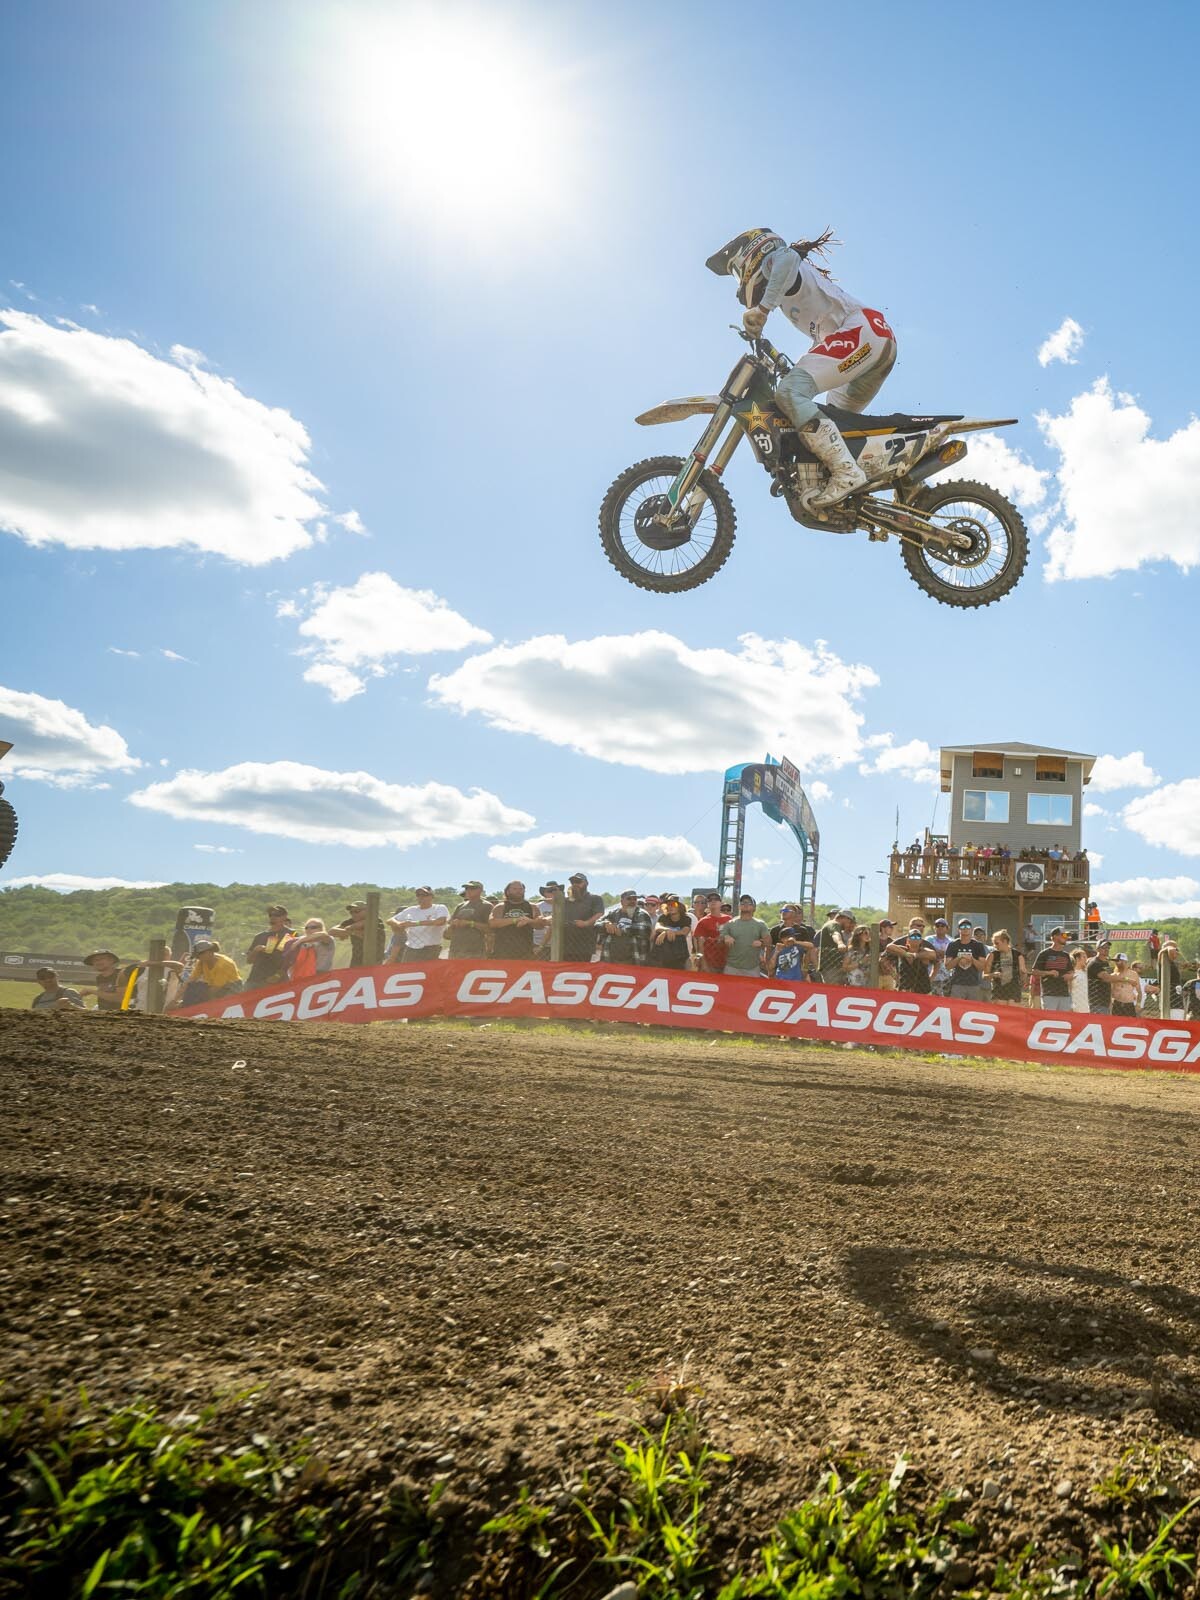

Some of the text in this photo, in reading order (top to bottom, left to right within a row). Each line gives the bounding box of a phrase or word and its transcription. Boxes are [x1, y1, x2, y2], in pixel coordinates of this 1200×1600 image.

[742, 233, 768, 257] SCOTT
[838, 343, 872, 374] ROCKSTAR
[885, 433, 927, 465] 27
[1020, 871, 1041, 879] WSR
[456, 970, 719, 1015] GASGAS
[748, 989, 999, 1044] GASGAS
